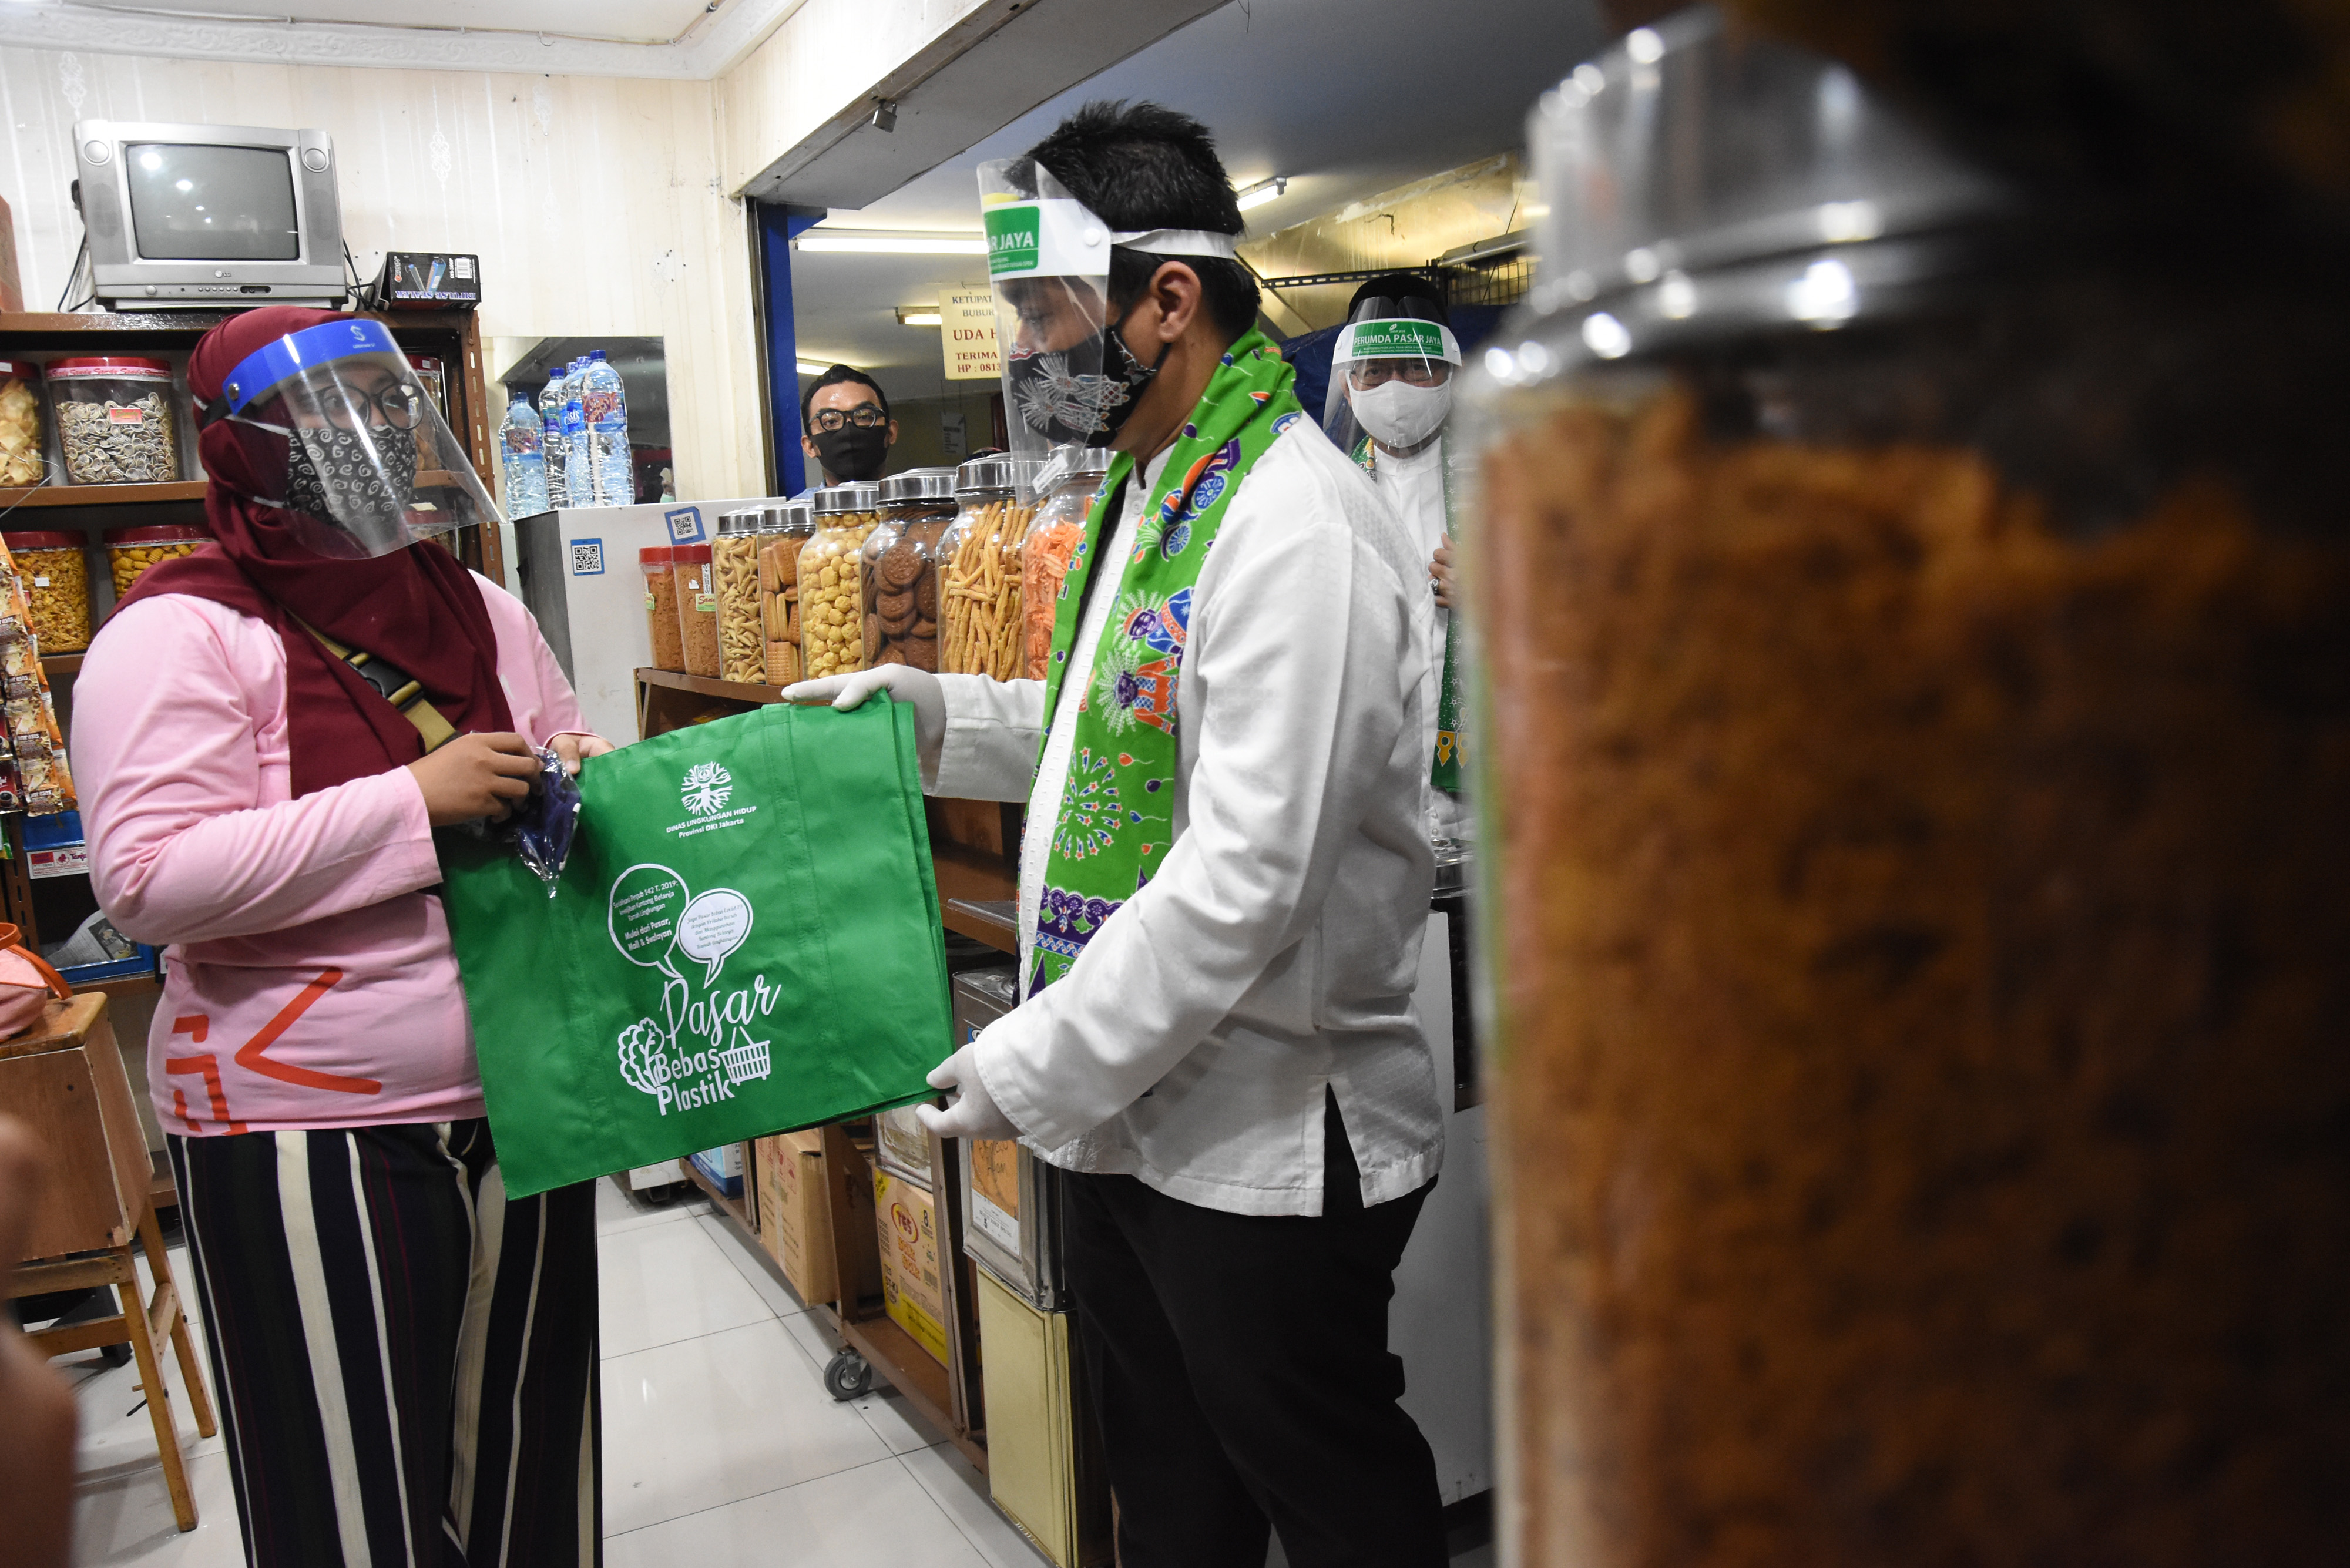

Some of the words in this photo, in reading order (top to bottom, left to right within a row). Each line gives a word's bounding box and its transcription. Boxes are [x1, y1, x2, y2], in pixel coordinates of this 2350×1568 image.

[999, 231, 1034, 251] JAYA
[395, 290, 433, 299] SEALER
[435, 291, 476, 300] IMPULSE
[952, 296, 992, 304] KETUPAT
[962, 309, 995, 317] BUBUR
[953, 329, 983, 341] UDA
[1354, 335, 1391, 345] PERUMDA
[1394, 334, 1424, 343] PASAR
[1426, 335, 1442, 345] JAYA
[955, 352, 998, 360] TERIMA
[958, 364, 971, 372] HP
[666, 822, 686, 833] DINAS
[686, 811, 732, 827] LINGKUNGAN
[733, 805, 757, 816] HIDUP
[679, 826, 704, 838] Provinsi
[706, 823, 718, 831] DKI
[719, 818, 744, 828] Jakarta
[644, 887, 654, 895] 142
[661, 880, 679, 890] 2019:
[654, 891, 674, 901] Belanja
[625, 928, 640, 940] Mulai
[640, 924, 651, 934] dari
[650, 918, 671, 930] Pasar,
[660, 974, 781, 1049] Pasar
[653, 1047, 720, 1084] Bebas
[657, 1070, 735, 1116] Plastik
